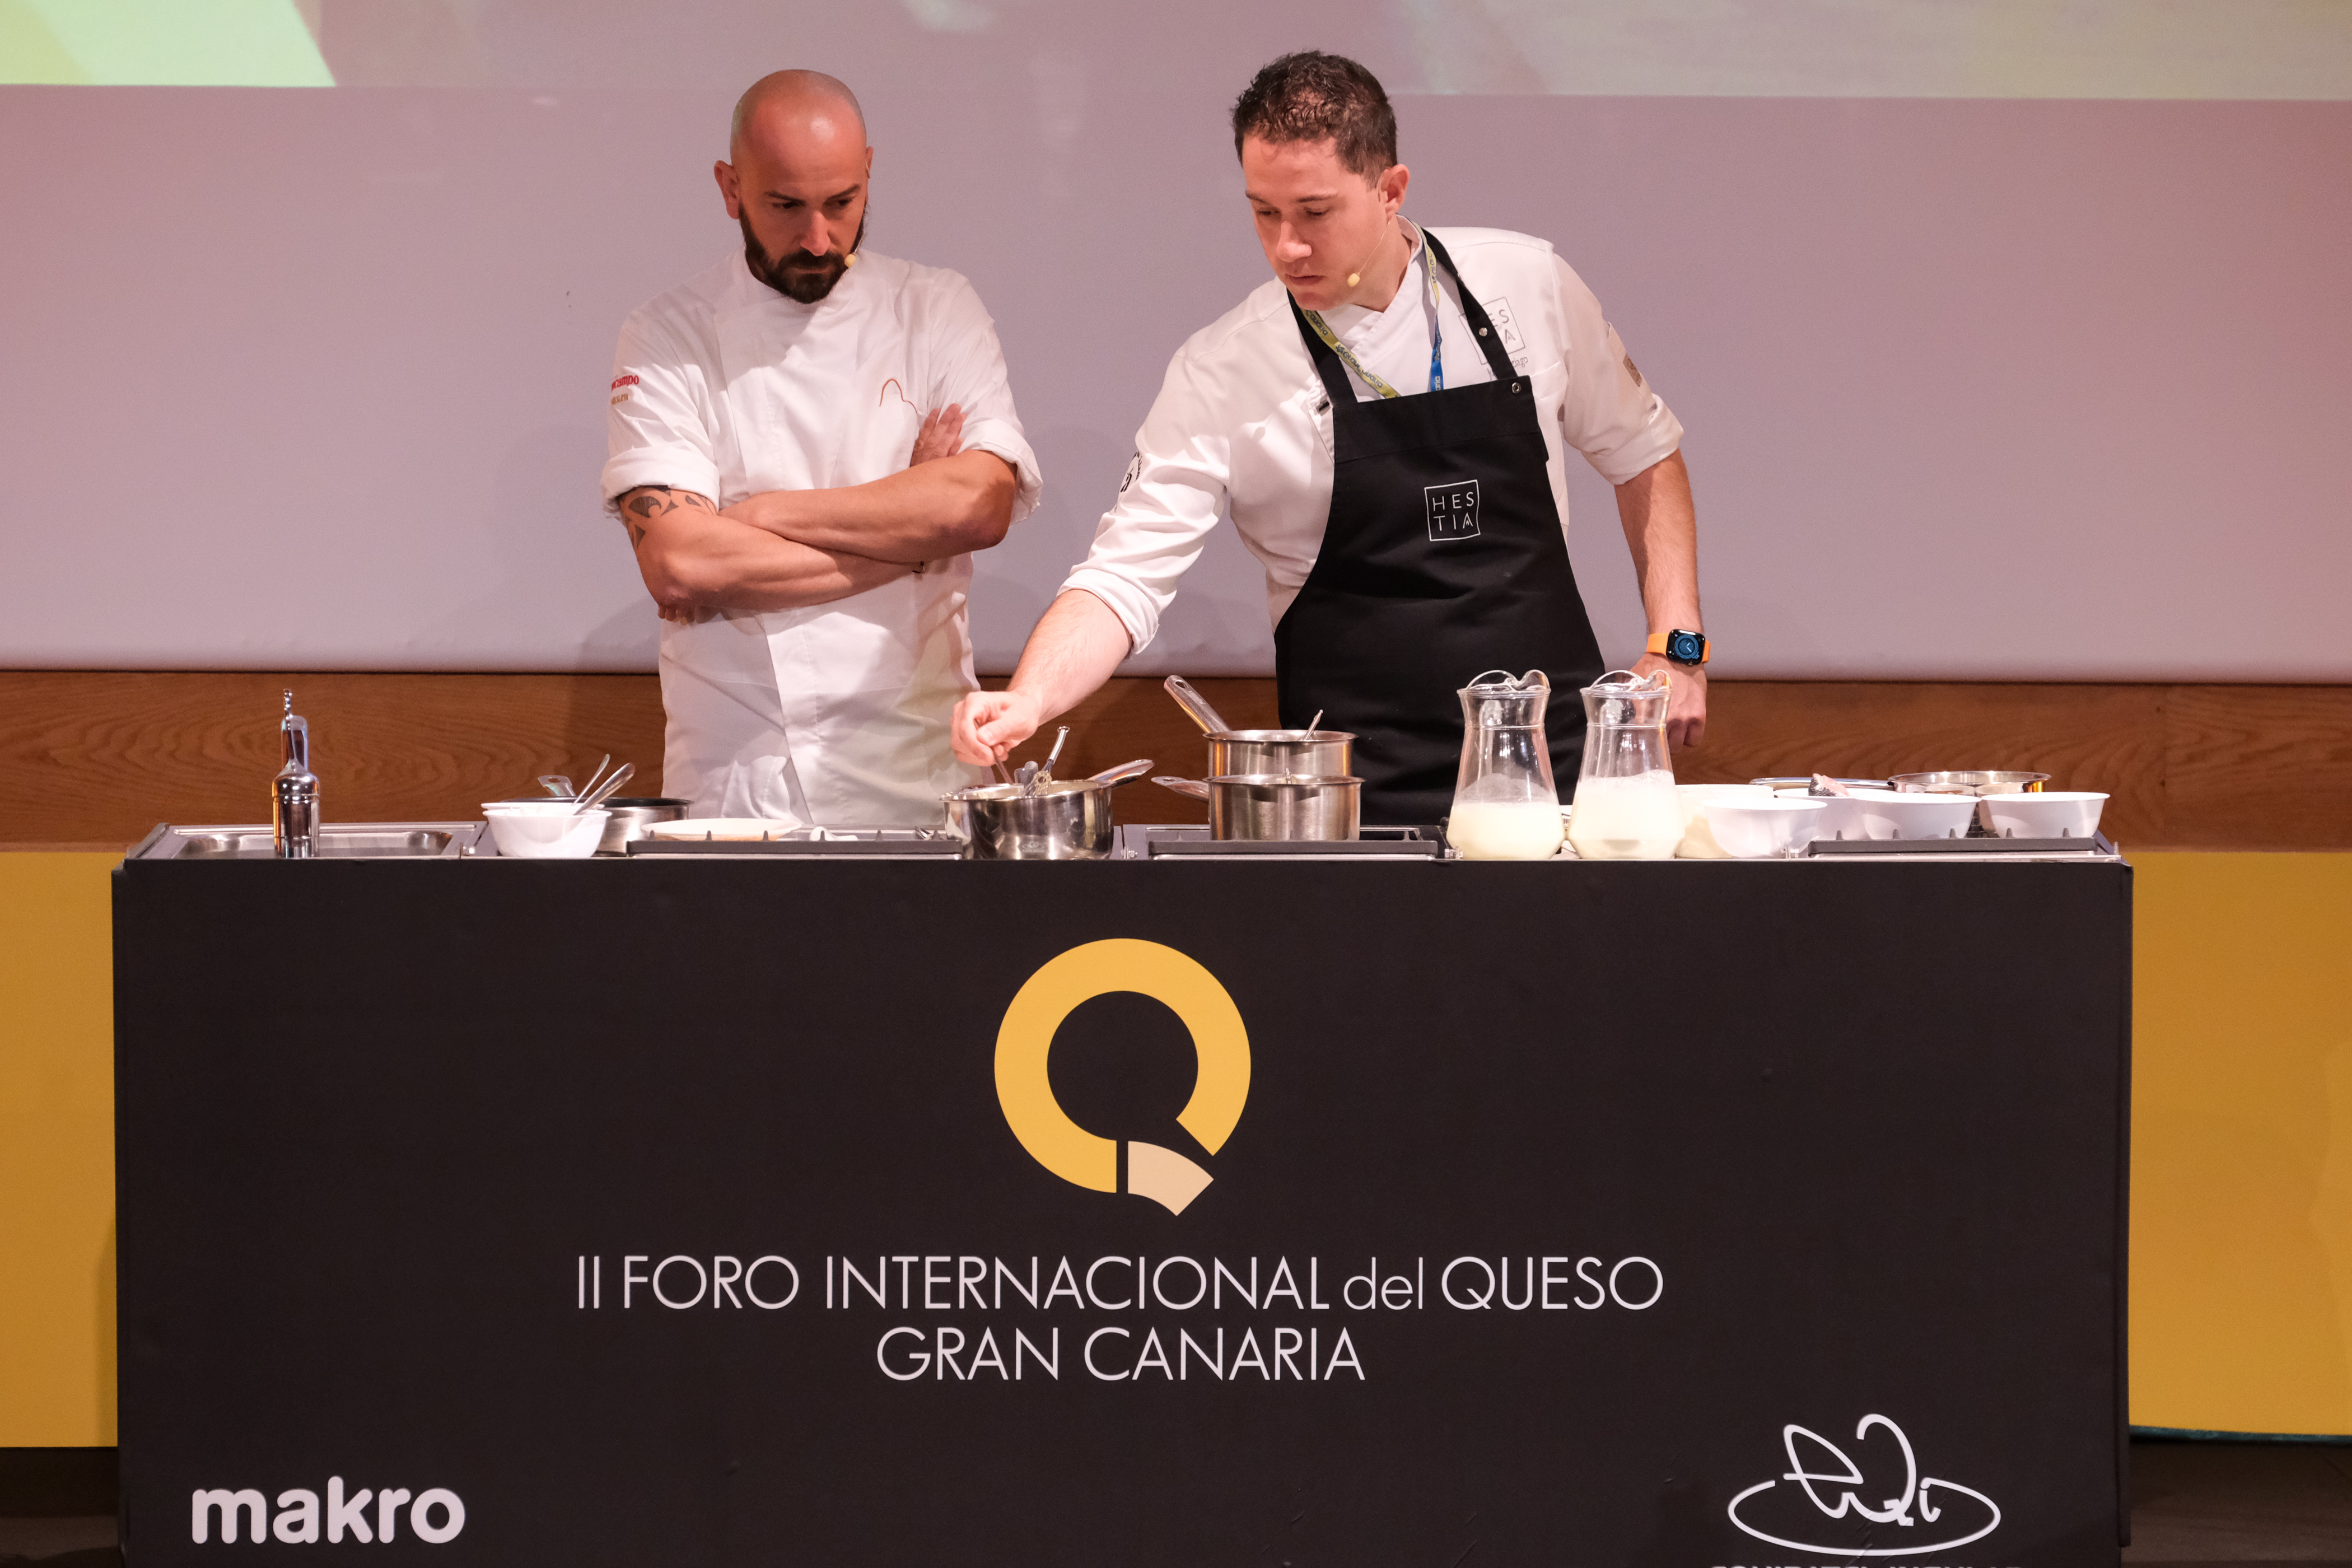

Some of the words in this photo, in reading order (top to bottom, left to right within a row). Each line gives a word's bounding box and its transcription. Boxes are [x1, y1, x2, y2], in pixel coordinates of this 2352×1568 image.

[1432, 491, 1474, 512] HES
[1433, 512, 1474, 531] TIA
[578, 1256, 600, 1309] II
[624, 1256, 799, 1310] FORO
[827, 1256, 1330, 1310] INTERNACIONAL
[1343, 1257, 1424, 1310] del
[1441, 1256, 1663, 1310] QUESO
[877, 1326, 1058, 1381] GRAN
[1084, 1327, 1365, 1381] CANARIA
[192, 1475, 466, 1544] makro
